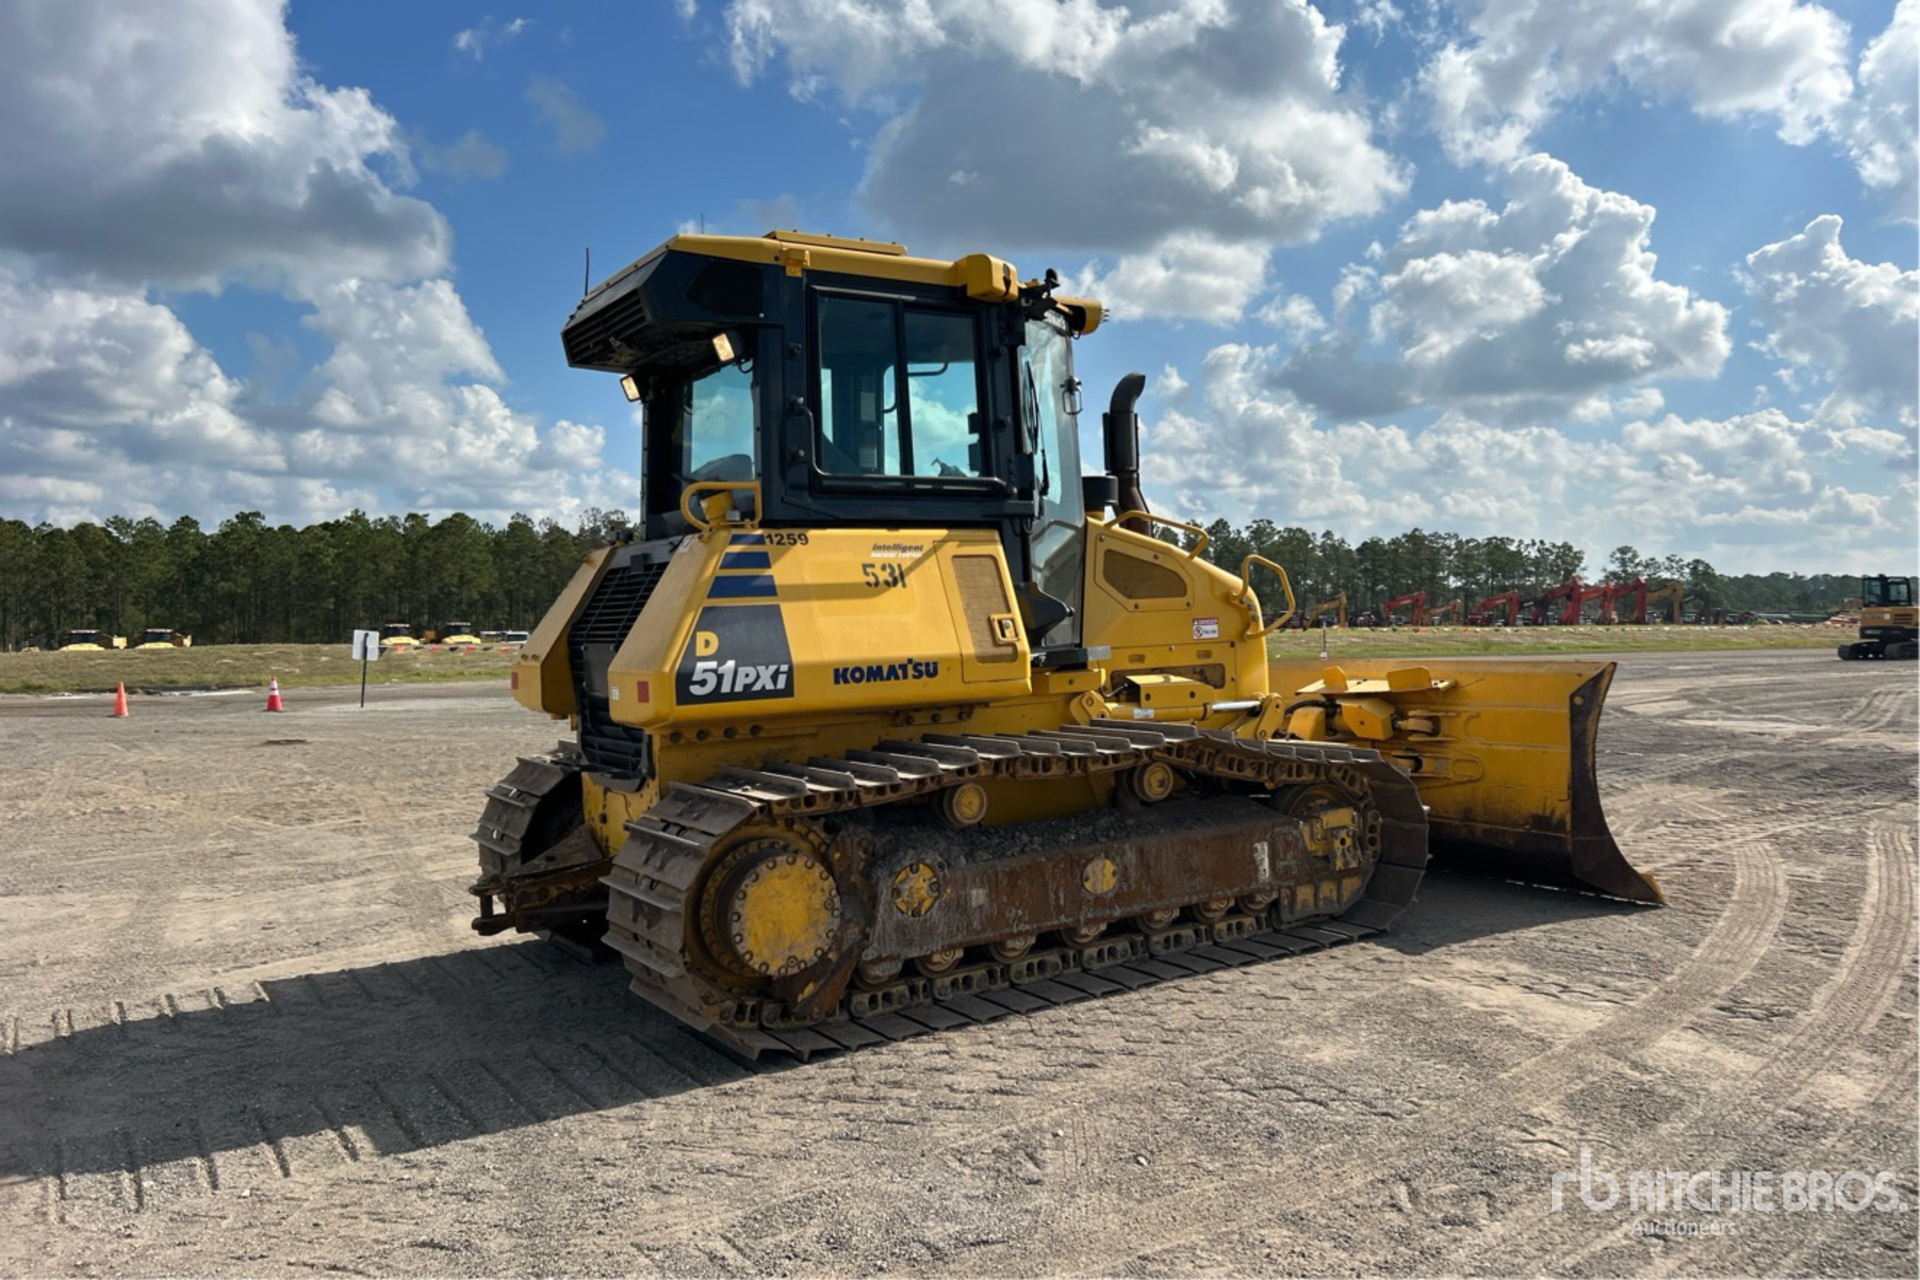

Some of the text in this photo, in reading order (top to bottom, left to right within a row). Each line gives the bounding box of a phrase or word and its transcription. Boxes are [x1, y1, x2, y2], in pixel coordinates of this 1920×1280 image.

[765, 533, 809, 546] 1259
[872, 542, 924, 553] intelligent
[695, 631, 719, 657] D
[689, 660, 789, 696] 51PXi
[833, 658, 939, 685] KOMATSU
